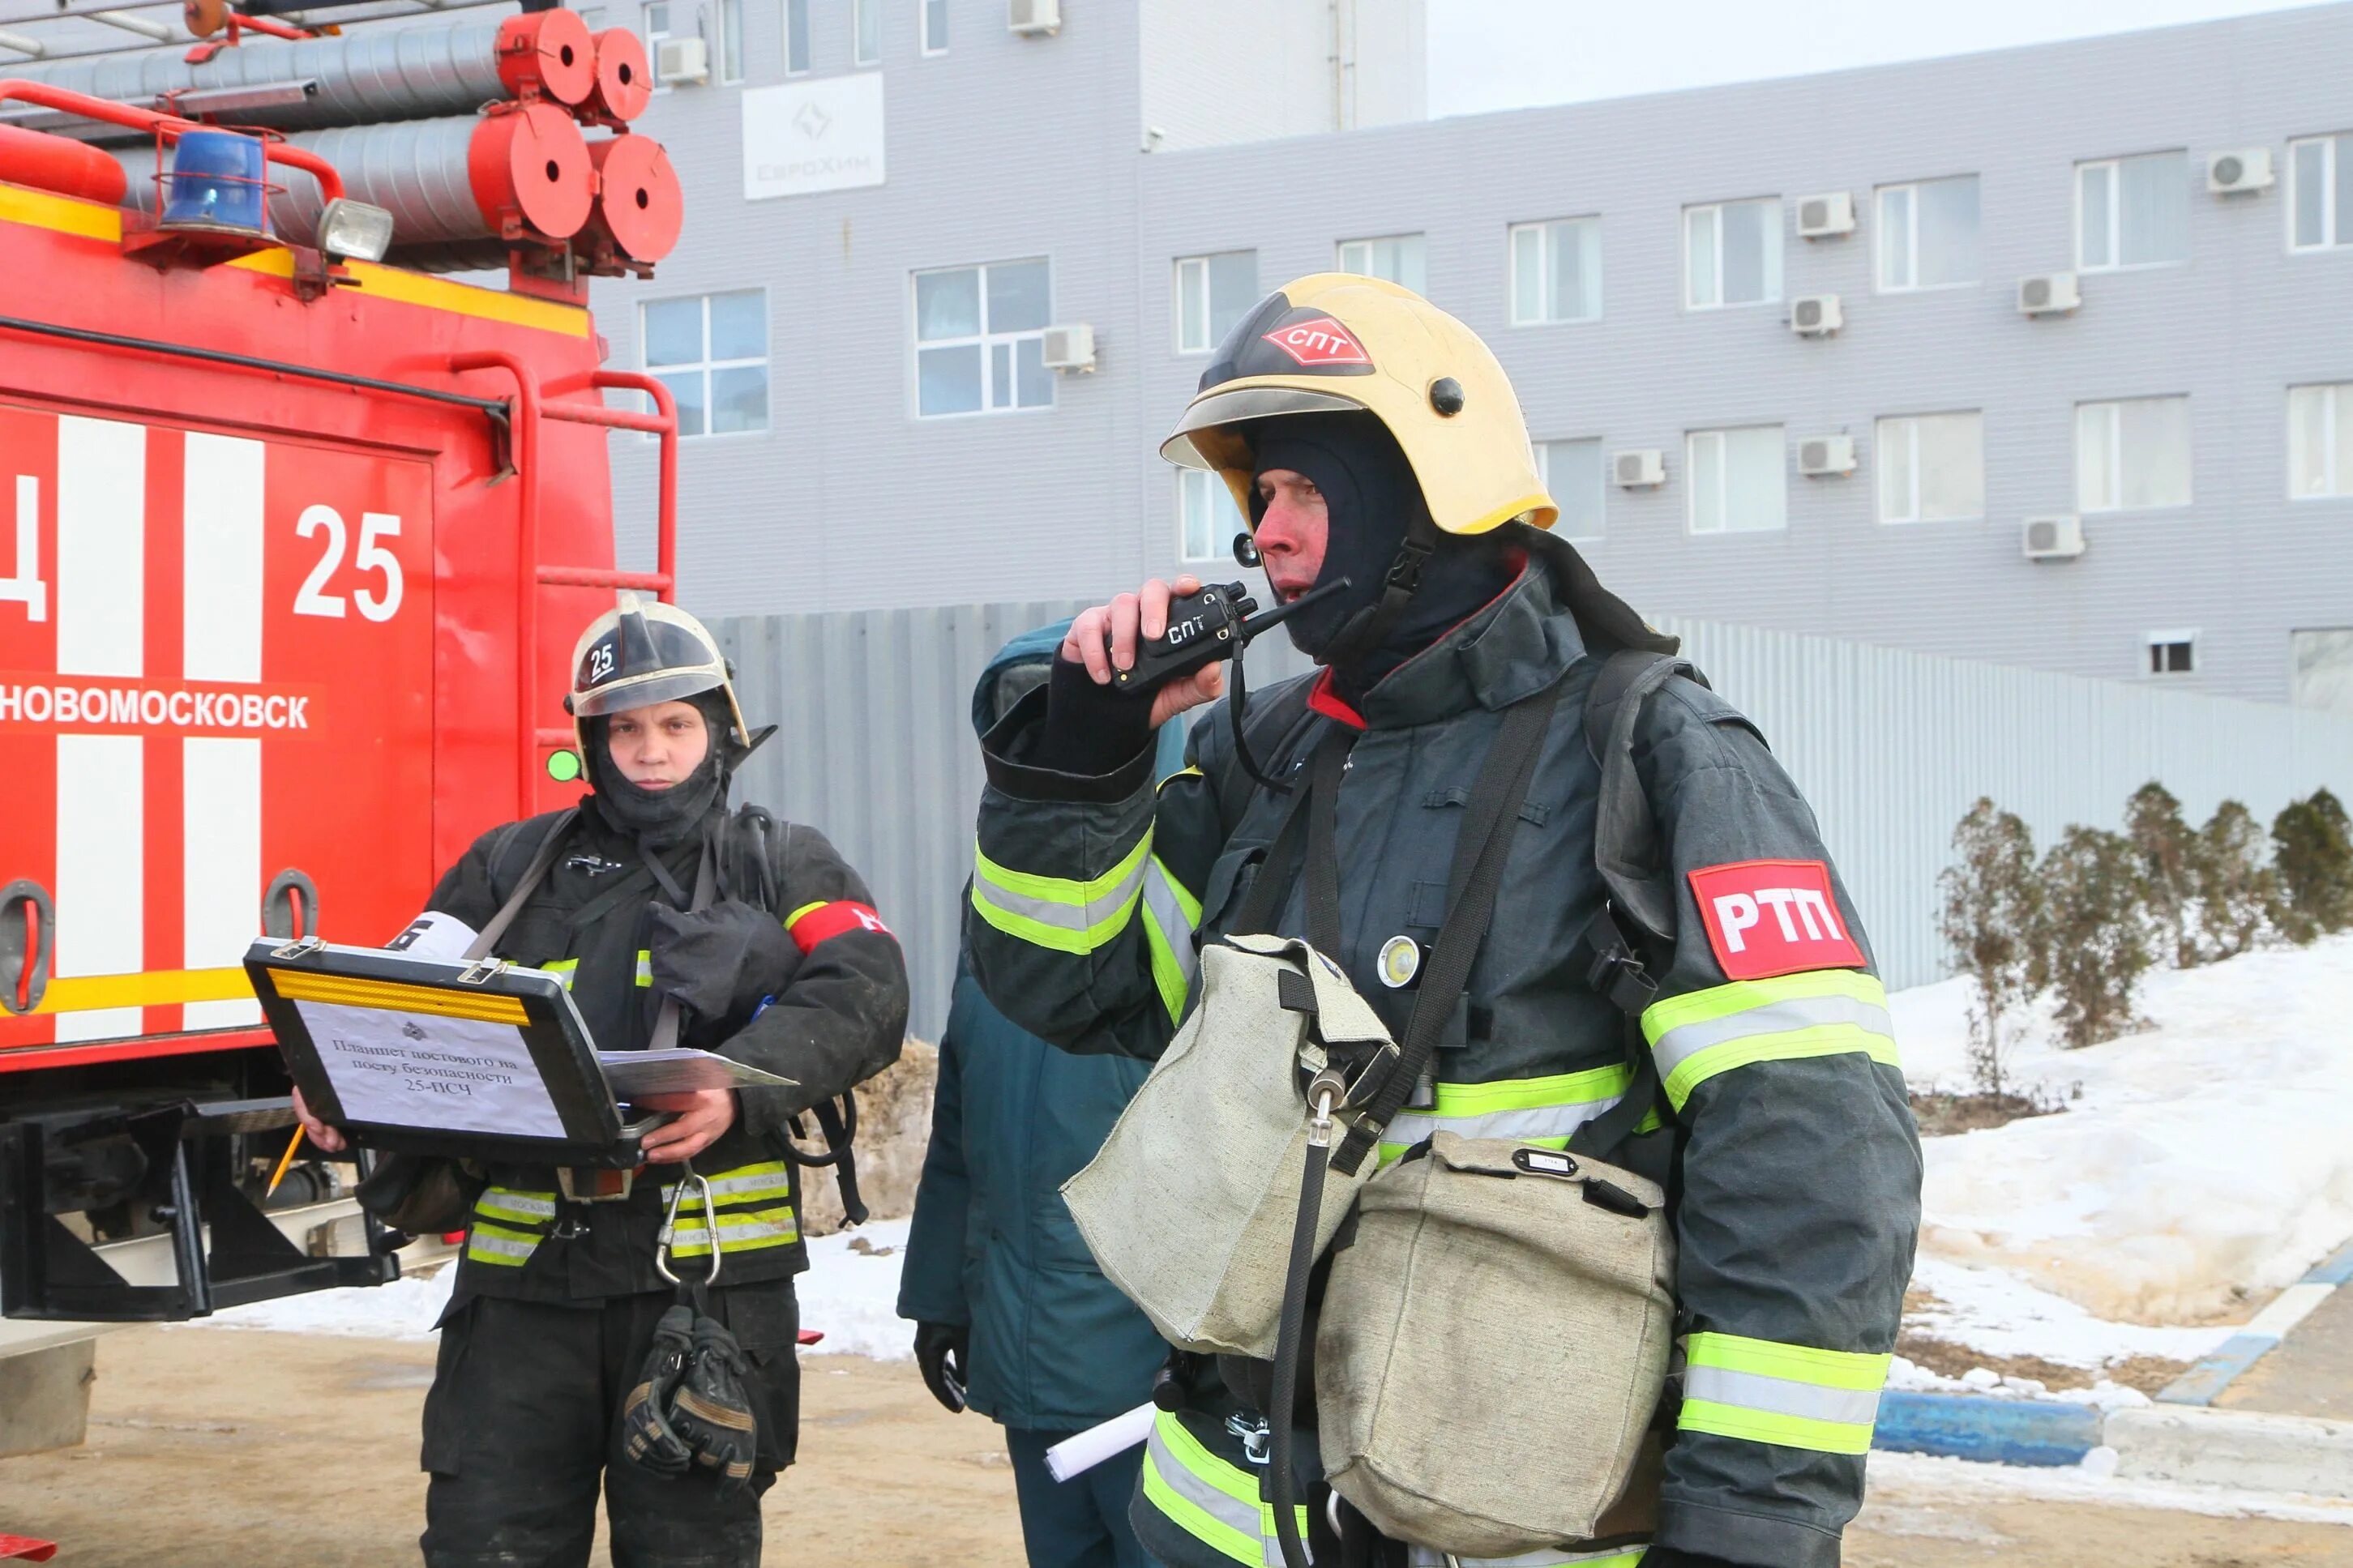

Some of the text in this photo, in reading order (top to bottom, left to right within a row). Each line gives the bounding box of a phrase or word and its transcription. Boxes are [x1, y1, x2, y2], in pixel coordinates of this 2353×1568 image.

[1287, 328, 1349, 355] СПТ
[293, 504, 404, 622] 25
[590, 643, 614, 678] 25
[0, 684, 309, 729] НОВОМОСКОВСК
[1712, 887, 1844, 954] РТП
[332, 1039, 520, 1070] Планшет постового на
[351, 1059, 513, 1085] посту безопасности
[404, 1078, 473, 1096] 25-ПСЧ
